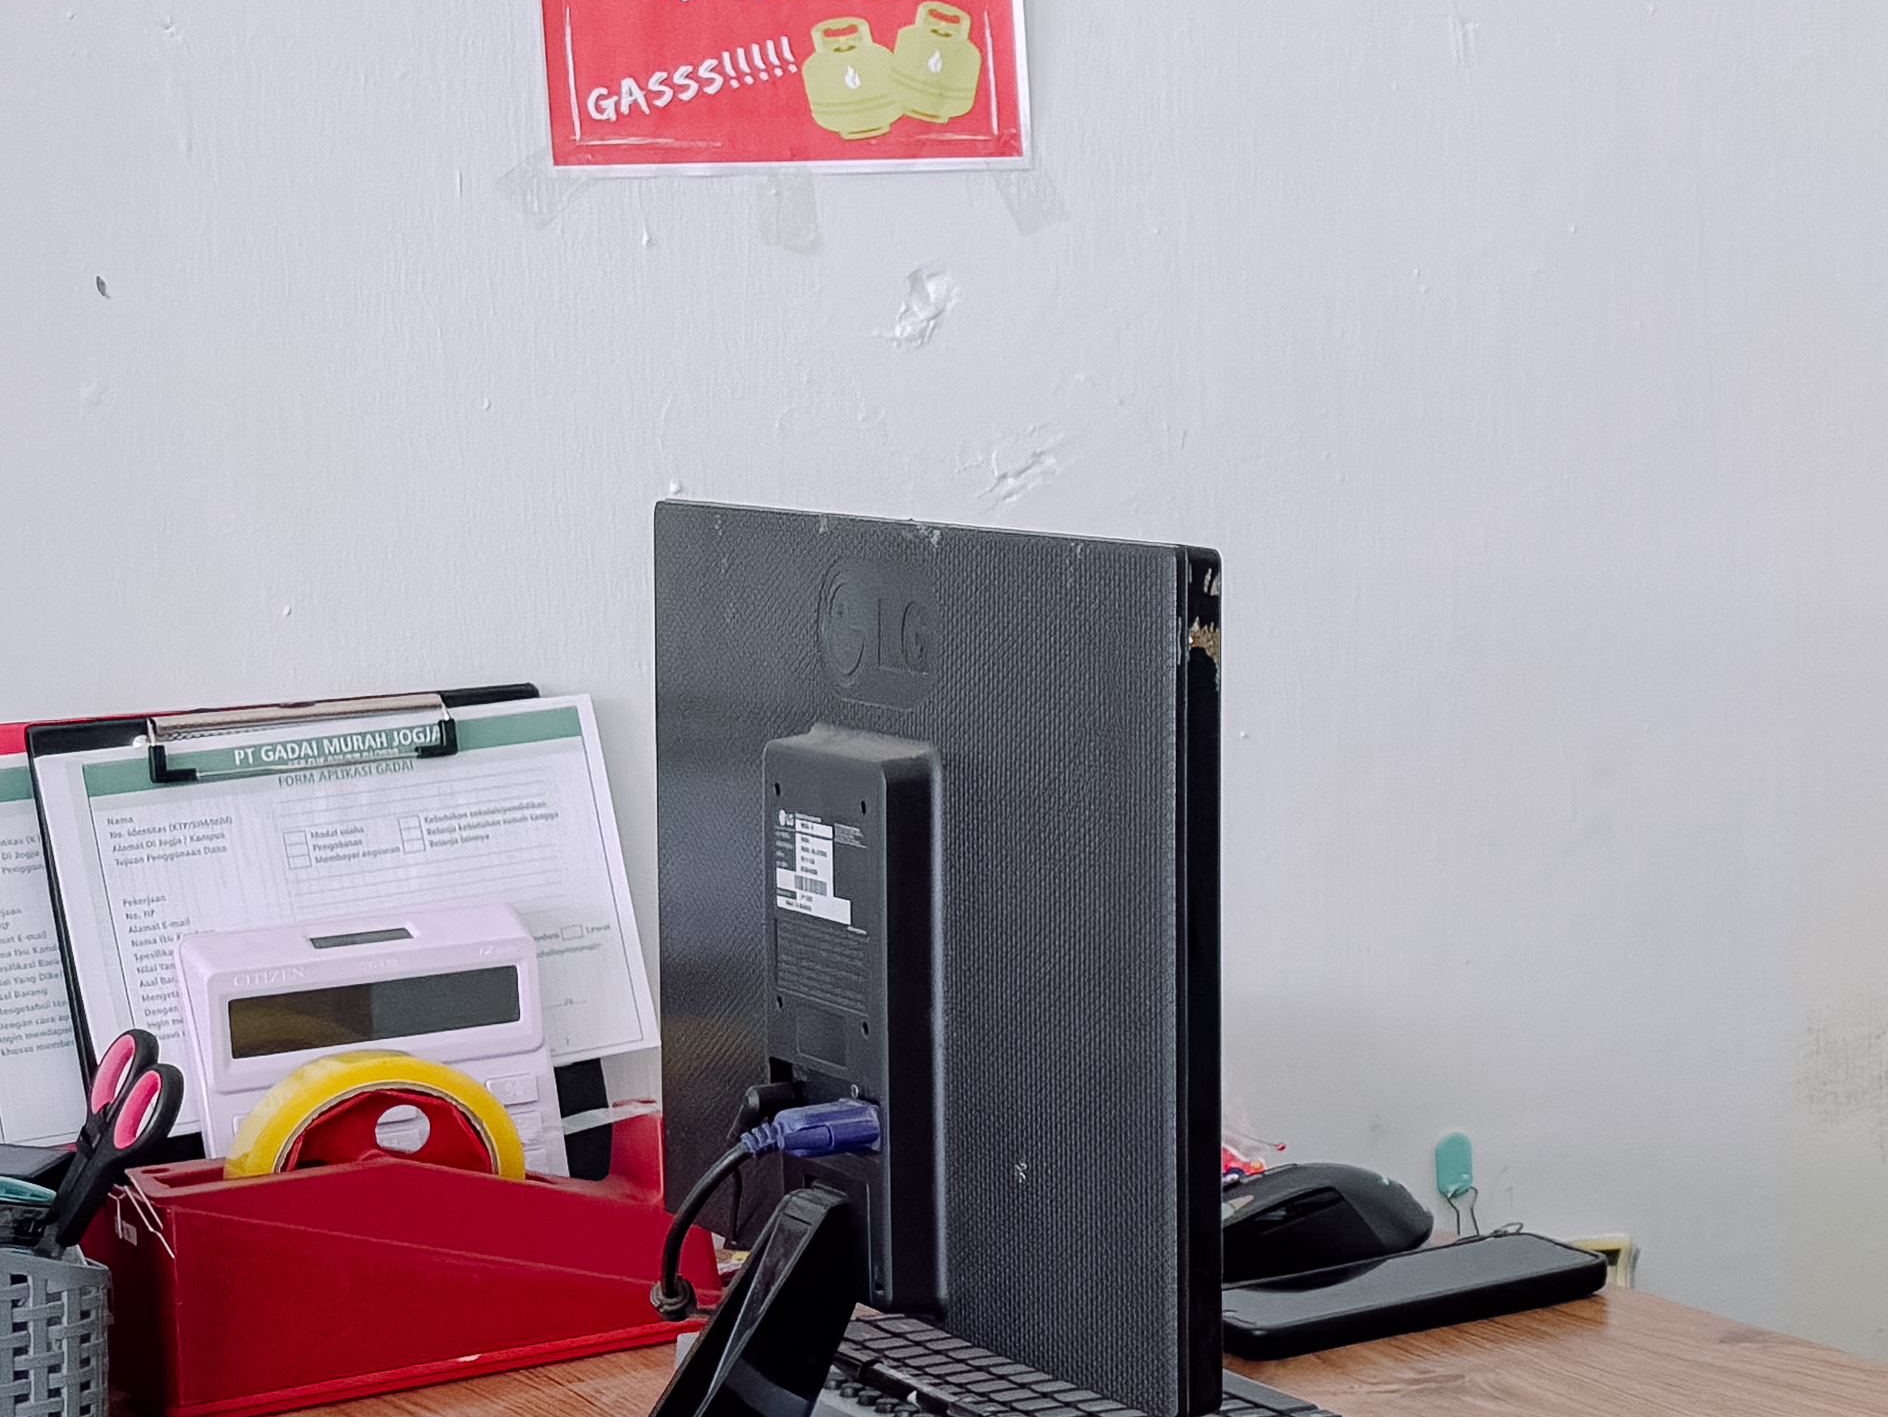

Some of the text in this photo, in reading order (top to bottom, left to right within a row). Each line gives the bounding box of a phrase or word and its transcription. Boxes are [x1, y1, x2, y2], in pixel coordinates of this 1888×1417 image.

[586, 36, 798, 122] GASSS!!!!!
[234, 748, 255, 766] PT
[261, 741, 319, 762] GADAI
[323, 732, 388, 755] MURAH
[392, 725, 441, 745] JOGJA
[278, 760, 414, 788] FORM APLIKASI GADAI
